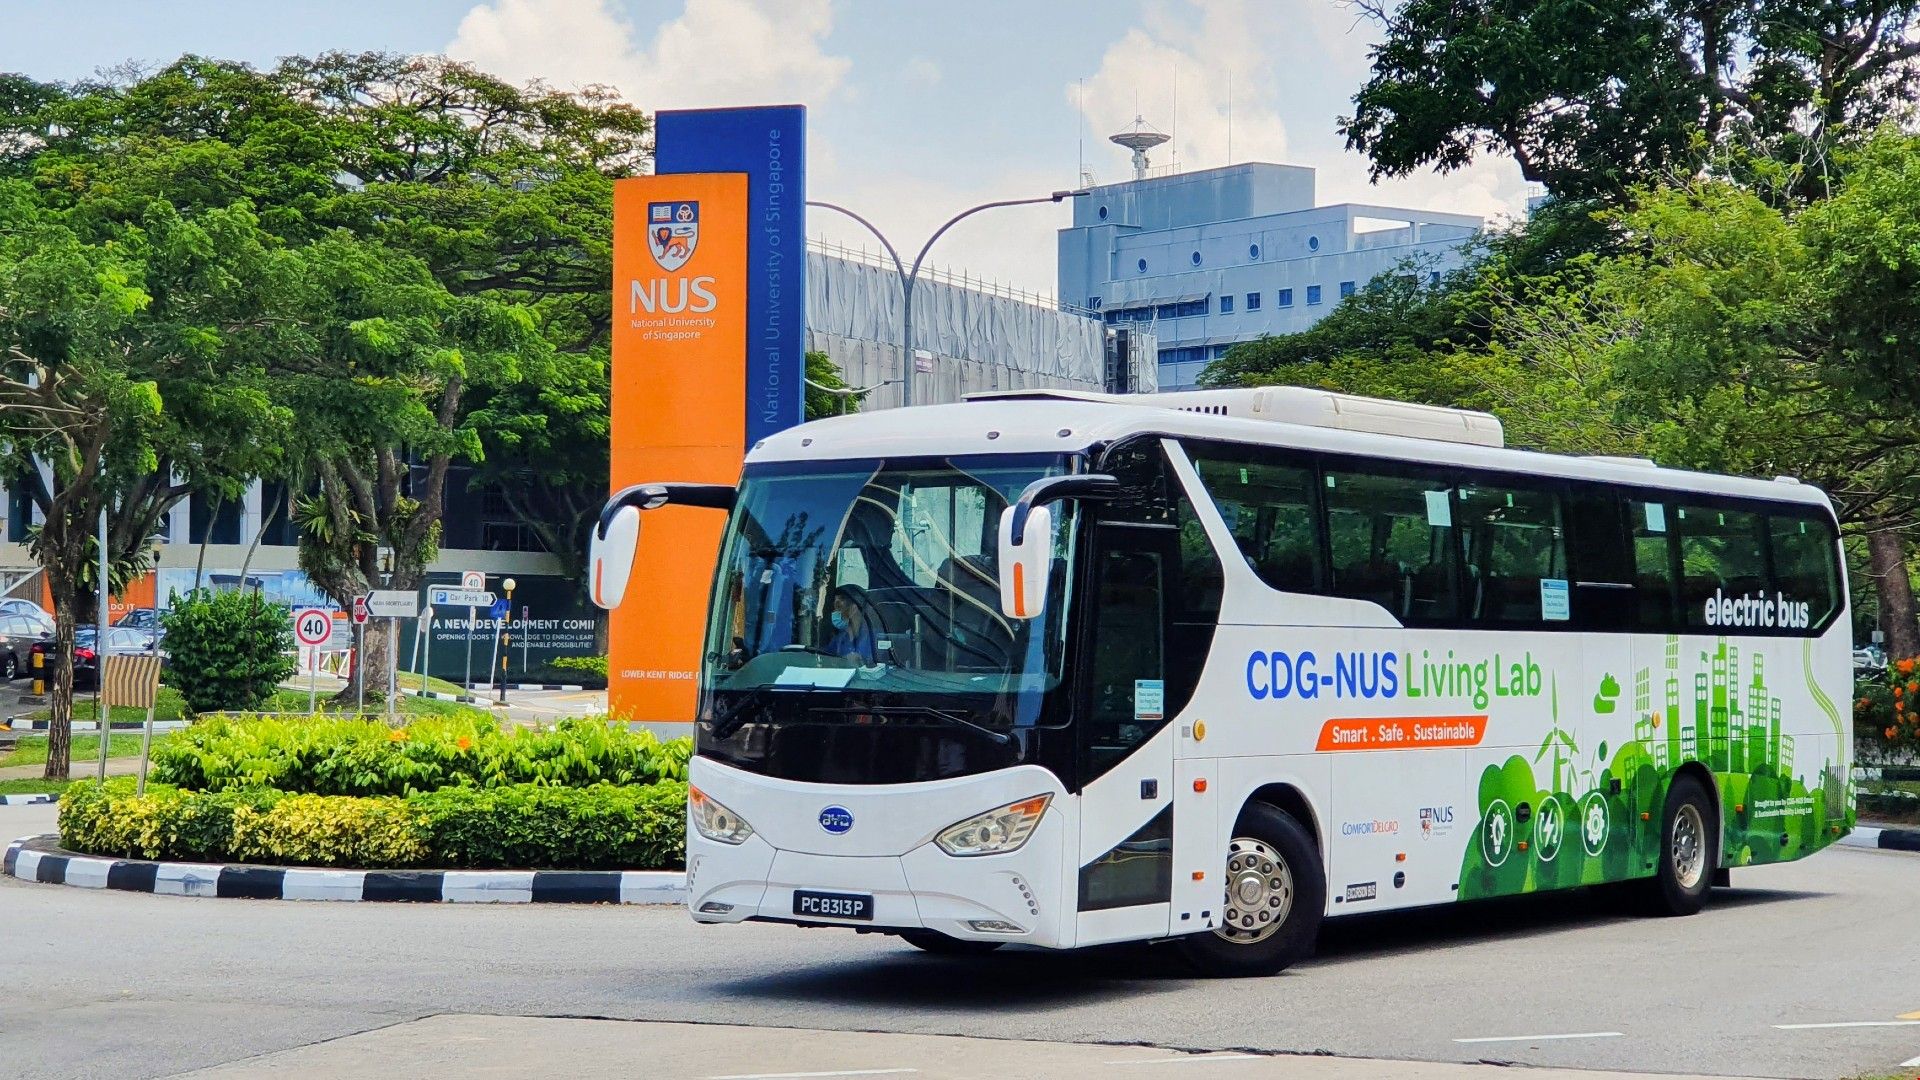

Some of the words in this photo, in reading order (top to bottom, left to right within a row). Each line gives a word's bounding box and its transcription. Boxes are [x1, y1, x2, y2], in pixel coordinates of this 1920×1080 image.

[765, 128, 784, 222] Singapore
[765, 225, 779, 246] of
[630, 276, 717, 314] NUS
[765, 251, 783, 341] University
[631, 318, 666, 328] National
[668, 317, 715, 331] University
[642, 330, 651, 340] of
[652, 331, 701, 342] Singapore
[765, 348, 780, 424] National
[468, 578, 479, 588] 40
[464, 594, 478, 602] Park
[111, 603, 123, 611] DO
[1705, 588, 1774, 628] electric
[1778, 591, 1809, 629] bus
[303, 619, 323, 635] 40
[432, 619, 442, 630] A
[444, 619, 473, 630] NEW
[511, 641, 525, 649] AND
[527, 641, 550, 649] ENABLE
[621, 669, 645, 678] LOWER
[646, 669, 667, 679] KENT
[669, 671, 693, 679] RIDGE
[1246, 650, 1398, 700] CDG-NUS
[1405, 649, 1489, 710] Living
[1495, 651, 1541, 697] Lab
[1332, 723, 1367, 744] Smart
[1378, 722, 1403, 742] Safe
[1413, 720, 1475, 740] Sustainable
[1432, 806, 1454, 823] NUS
[800, 895, 864, 917] PC8313P
